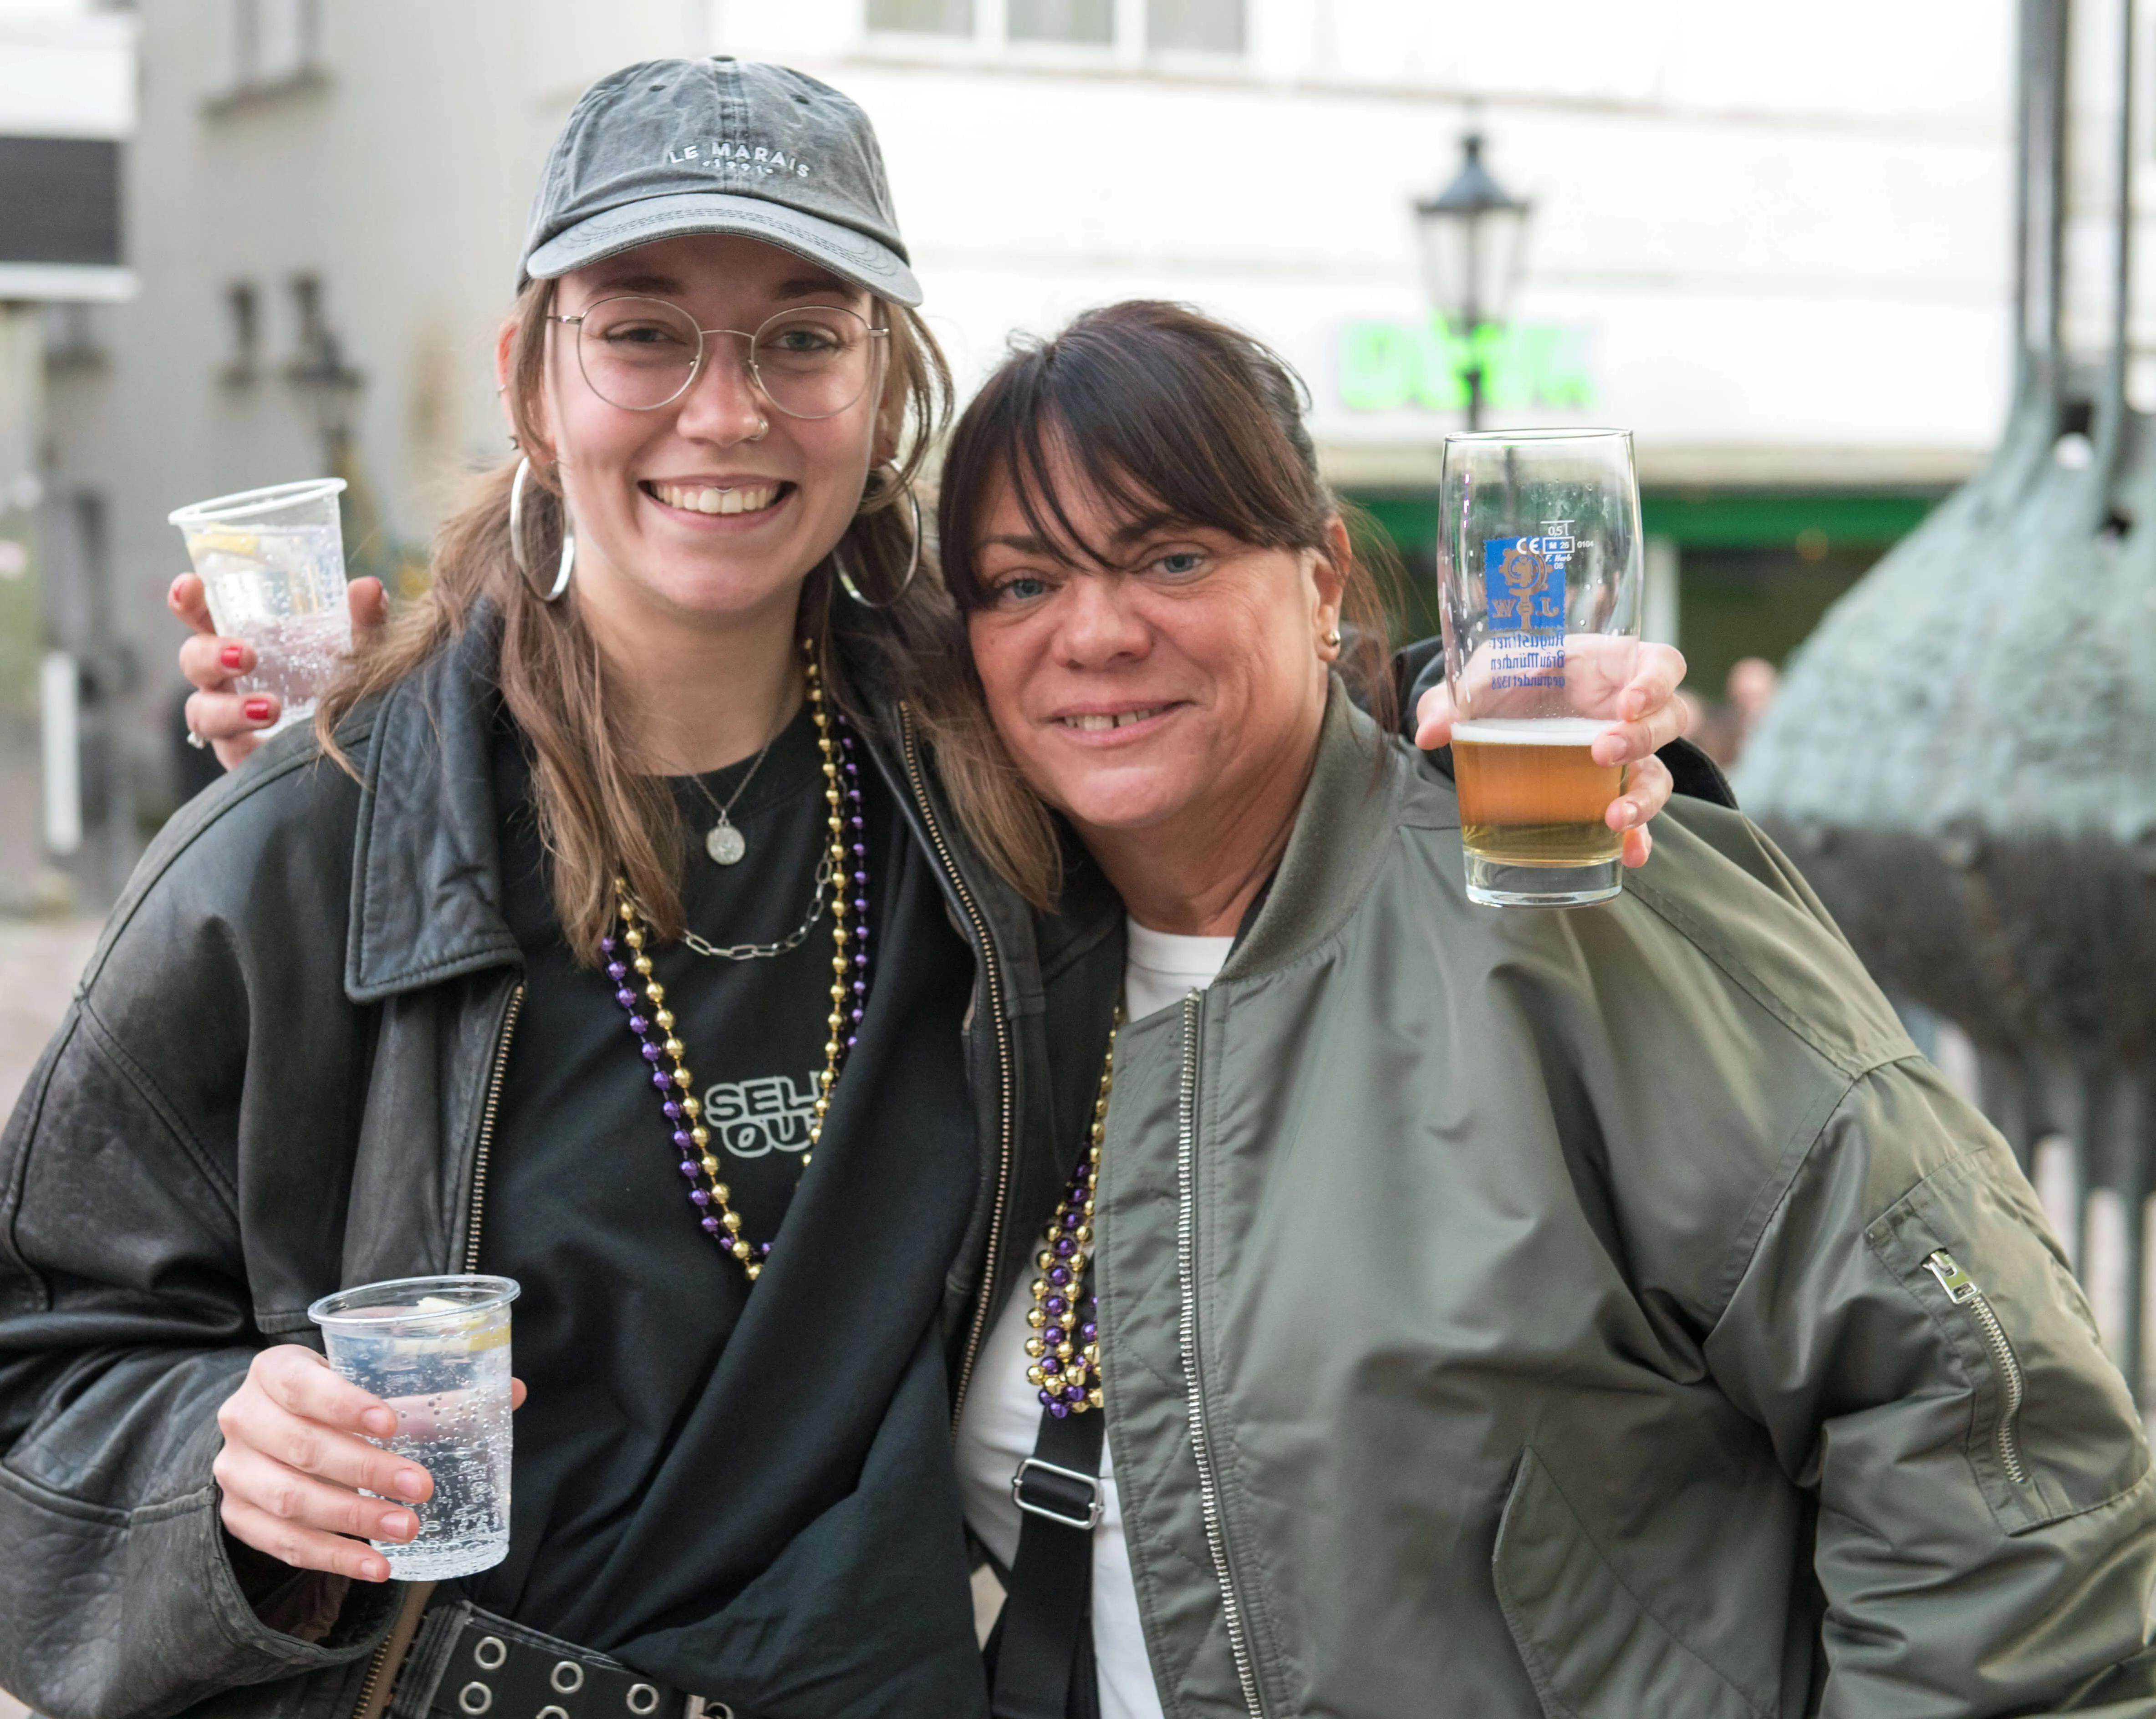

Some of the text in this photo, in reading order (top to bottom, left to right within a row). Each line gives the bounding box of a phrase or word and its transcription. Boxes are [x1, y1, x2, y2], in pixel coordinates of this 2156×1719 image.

[669, 142, 810, 178] LE MARAIS
[1516, 538, 1540, 554] CE
[704, 1071, 823, 1128] SEL
